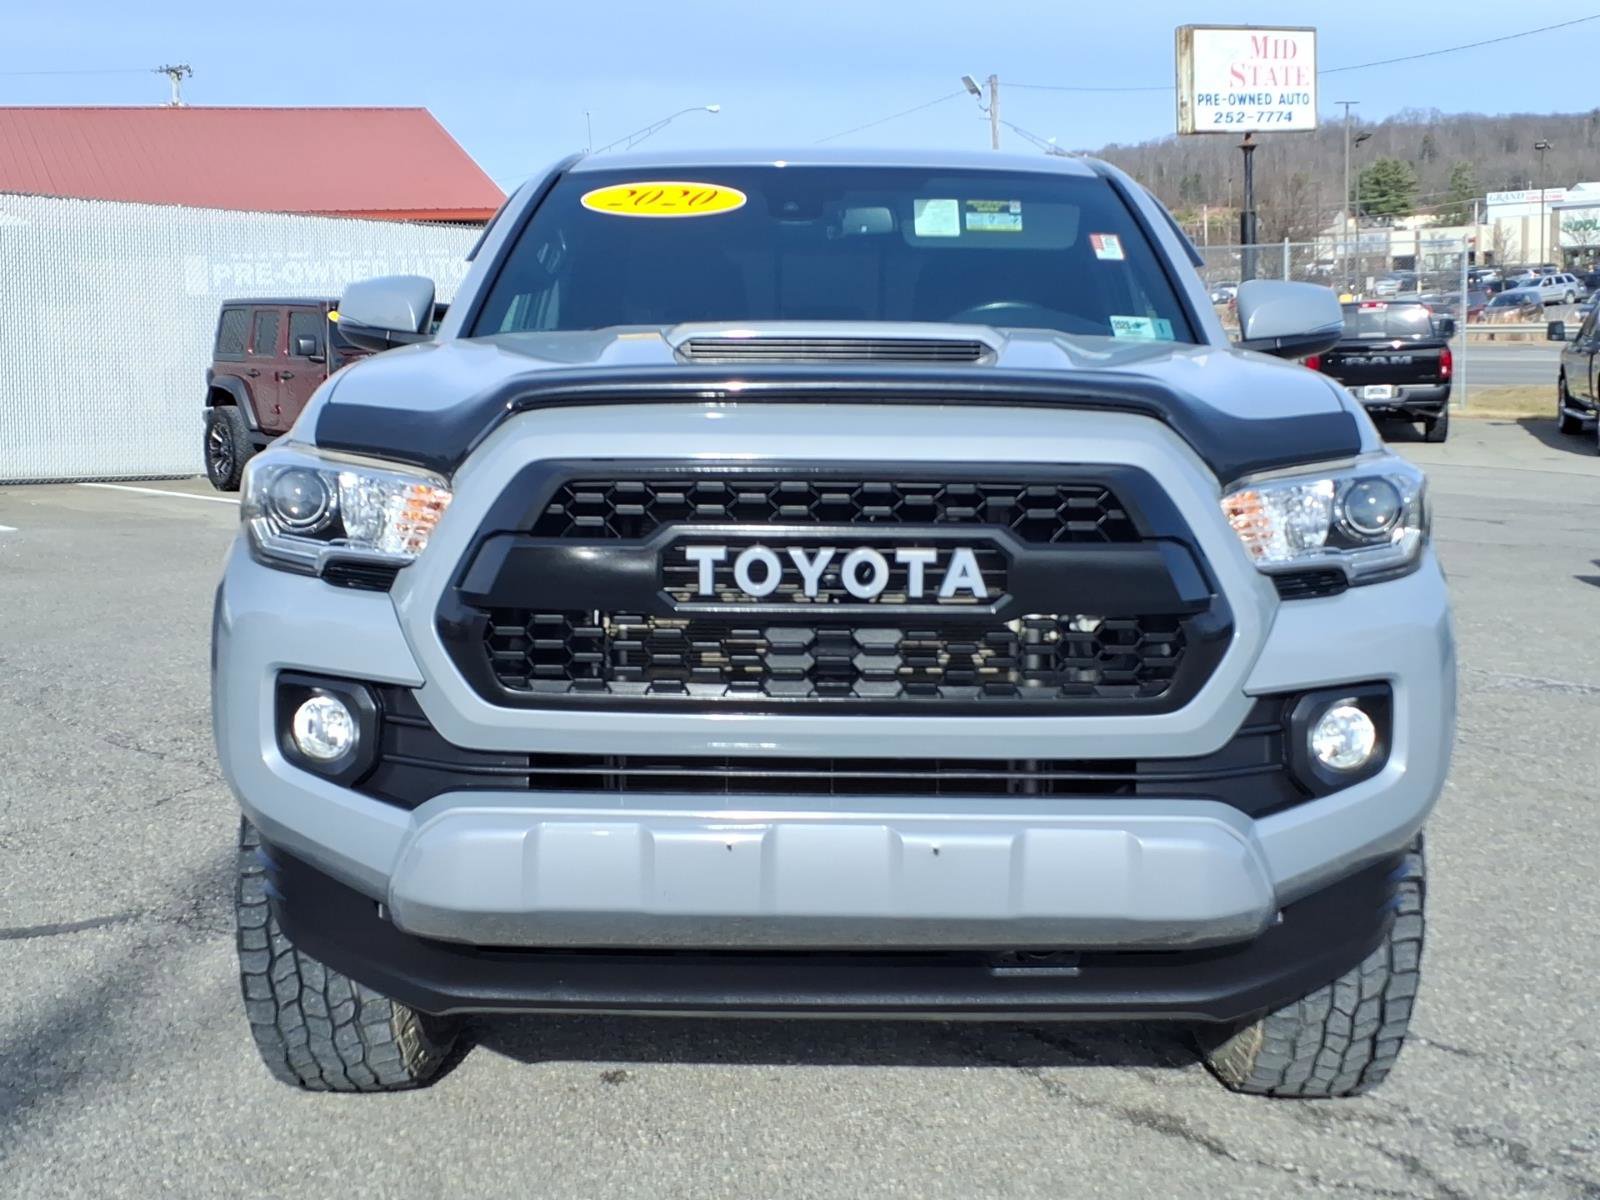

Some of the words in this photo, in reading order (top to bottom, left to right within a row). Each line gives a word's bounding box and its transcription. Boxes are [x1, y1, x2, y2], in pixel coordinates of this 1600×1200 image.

[1229, 63, 1310, 87] STATE
[1197, 93, 1272, 106] PRE-OWNED
[1278, 92, 1310, 105] AUTO
[1213, 111, 1293, 124] 252-7774
[607, 189, 719, 207] 2020
[1345, 356, 1413, 366] RAM
[684, 545, 989, 600] TOYOTA
